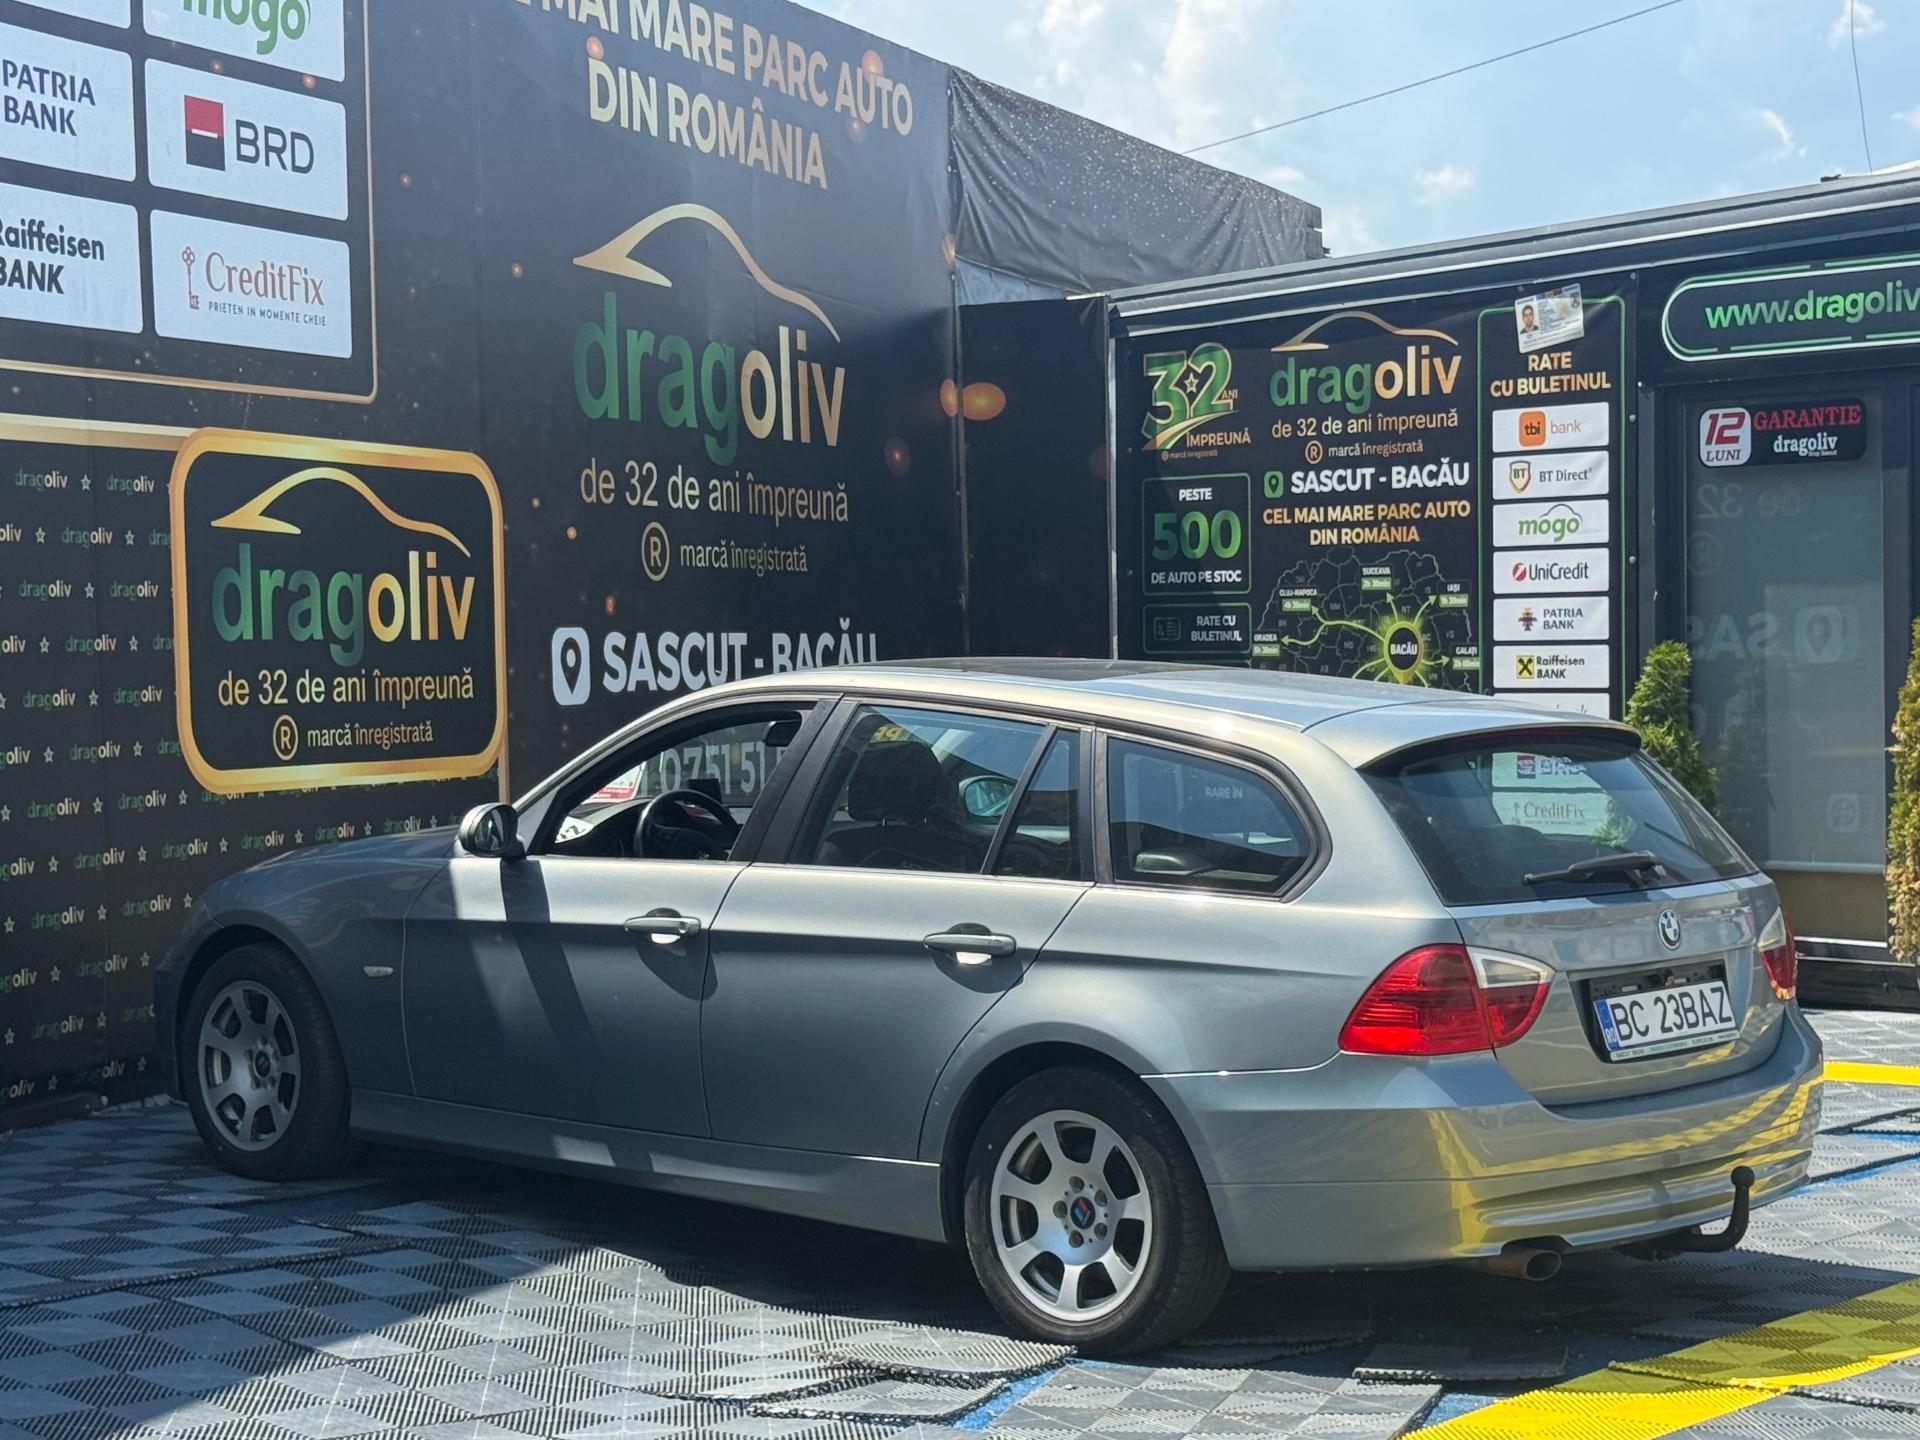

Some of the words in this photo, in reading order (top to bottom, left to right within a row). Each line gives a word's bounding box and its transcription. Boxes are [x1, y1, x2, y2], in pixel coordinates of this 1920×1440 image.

[629, 0, 735, 75] MARE
[742, 23, 828, 107] PARC
[835, 62, 913, 136] AUTO
[2, 60, 96, 106] PATRIA
[4, 95, 77, 137] BANK
[588, 57, 658, 137] DIN
[668, 83, 827, 189] ROMÂNIA
[235, 119, 314, 174] BRD
[206, 252, 324, 305] CreditFix
[208, 301, 243, 315] PRIETEN
[260, 309, 300, 323] MOMENTE
[303, 314, 326, 326] CHEIE
[1528, 351, 1572, 371] RATE
[572, 291, 845, 466] dragoliv
[1142, 342, 1233, 440] 32
[1270, 345, 1461, 414] dragoliv
[1490, 380, 1513, 397] CU
[1517, 372, 1611, 395] BULETINUL
[1222, 389, 1238, 400] ANI
[1272, 420, 1292, 438] de
[1297, 417, 1317, 436] 32
[1322, 416, 1342, 436] de
[1347, 414, 1372, 434] ani
[1377, 408, 1458, 434] împreună
[1524, 421, 1541, 435] tbi
[1550, 419, 1582, 434] bank
[1705, 412, 1745, 445] 12
[1753, 405, 1861, 431] GARANTIE
[1186, 427, 1251, 447] ÎMPREUNĂ
[1328, 444, 1360, 457] marcă
[1362, 440, 1423, 457] înregistrată
[1706, 449, 1740, 463] LUNI
[1773, 432, 1837, 456] dragoliv
[15, 469, 68, 491] dragoliv
[106, 475, 154, 494] dragoliv
[1291, 467, 1375, 494] SASCUT
[1391, 457, 1470, 489] BACĂU
[1513, 468, 1526, 479] BT
[1539, 471, 1553, 482] BT
[580, 457, 615, 504] de
[625, 459, 658, 507] 32
[668, 464, 700, 510] de
[708, 471, 741, 513] ani
[747, 472, 848, 527] împreună
[1178, 488, 1212, 501] PESTE
[1263, 508, 1291, 524] CEL
[1294, 507, 1324, 523] MAI
[1327, 504, 1374, 522] MARE
[1378, 502, 1421, 520] PARC
[1424, 500, 1471, 518] AUTO
[61, 527, 113, 548] dragoliv
[1152, 509, 1241, 561] 500
[1310, 528, 1338, 545] DIN
[1341, 523, 1420, 544] ROMÂNIA
[1518, 518, 1580, 542] mogo
[680, 540, 728, 568] marcă
[731, 540, 808, 577] înregistrată
[1151, 572, 1166, 584] DE
[1167, 572, 1196, 584] AUTO
[1198, 571, 1212, 583] PE
[1214, 570, 1242, 583] STOC
[1529, 562, 1589, 581] UniCredit
[19, 580, 72, 600] dragoliv
[110, 580, 159, 601] dragoliv
[211, 543, 475, 667] dragoliv
[1543, 608, 1583, 618] PATRIA
[1196, 615, 1221, 626] RATE
[1222, 614, 1236, 626] CU
[1543, 620, 1575, 630] BANK
[65, 634, 117, 655] dragoliv
[1191, 630, 1242, 642] BULETINUL
[1390, 641, 1417, 655] BACĂU
[603, 631, 747, 693] SASCUT
[1536, 655, 1585, 666] Raiffeisen
[1537, 669, 1566, 679] BANK
[23, 689, 76, 710] dragoliv
[113, 685, 163, 707] dragoliv
[218, 671, 249, 706] de
[258, 669, 288, 705] 32
[296, 669, 325, 703] de
[333, 669, 366, 702] ani
[373, 668, 474, 709] împreună
[307, 722, 352, 748] marcă
[355, 720, 433, 750] înregistrată
[70, 741, 121, 763] dragoliv
[27, 798, 80, 820] dragoliv
[118, 790, 167, 812] dragoliv
[74, 848, 125, 870] dragoliv
[162, 839, 208, 860] dragoliv
[32, 906, 85, 929] dragoliv
[123, 894, 172, 917] dragoliv
[1609, 1000, 1649, 1041] BC
[1654, 987, 1732, 1033] 23BAZ
